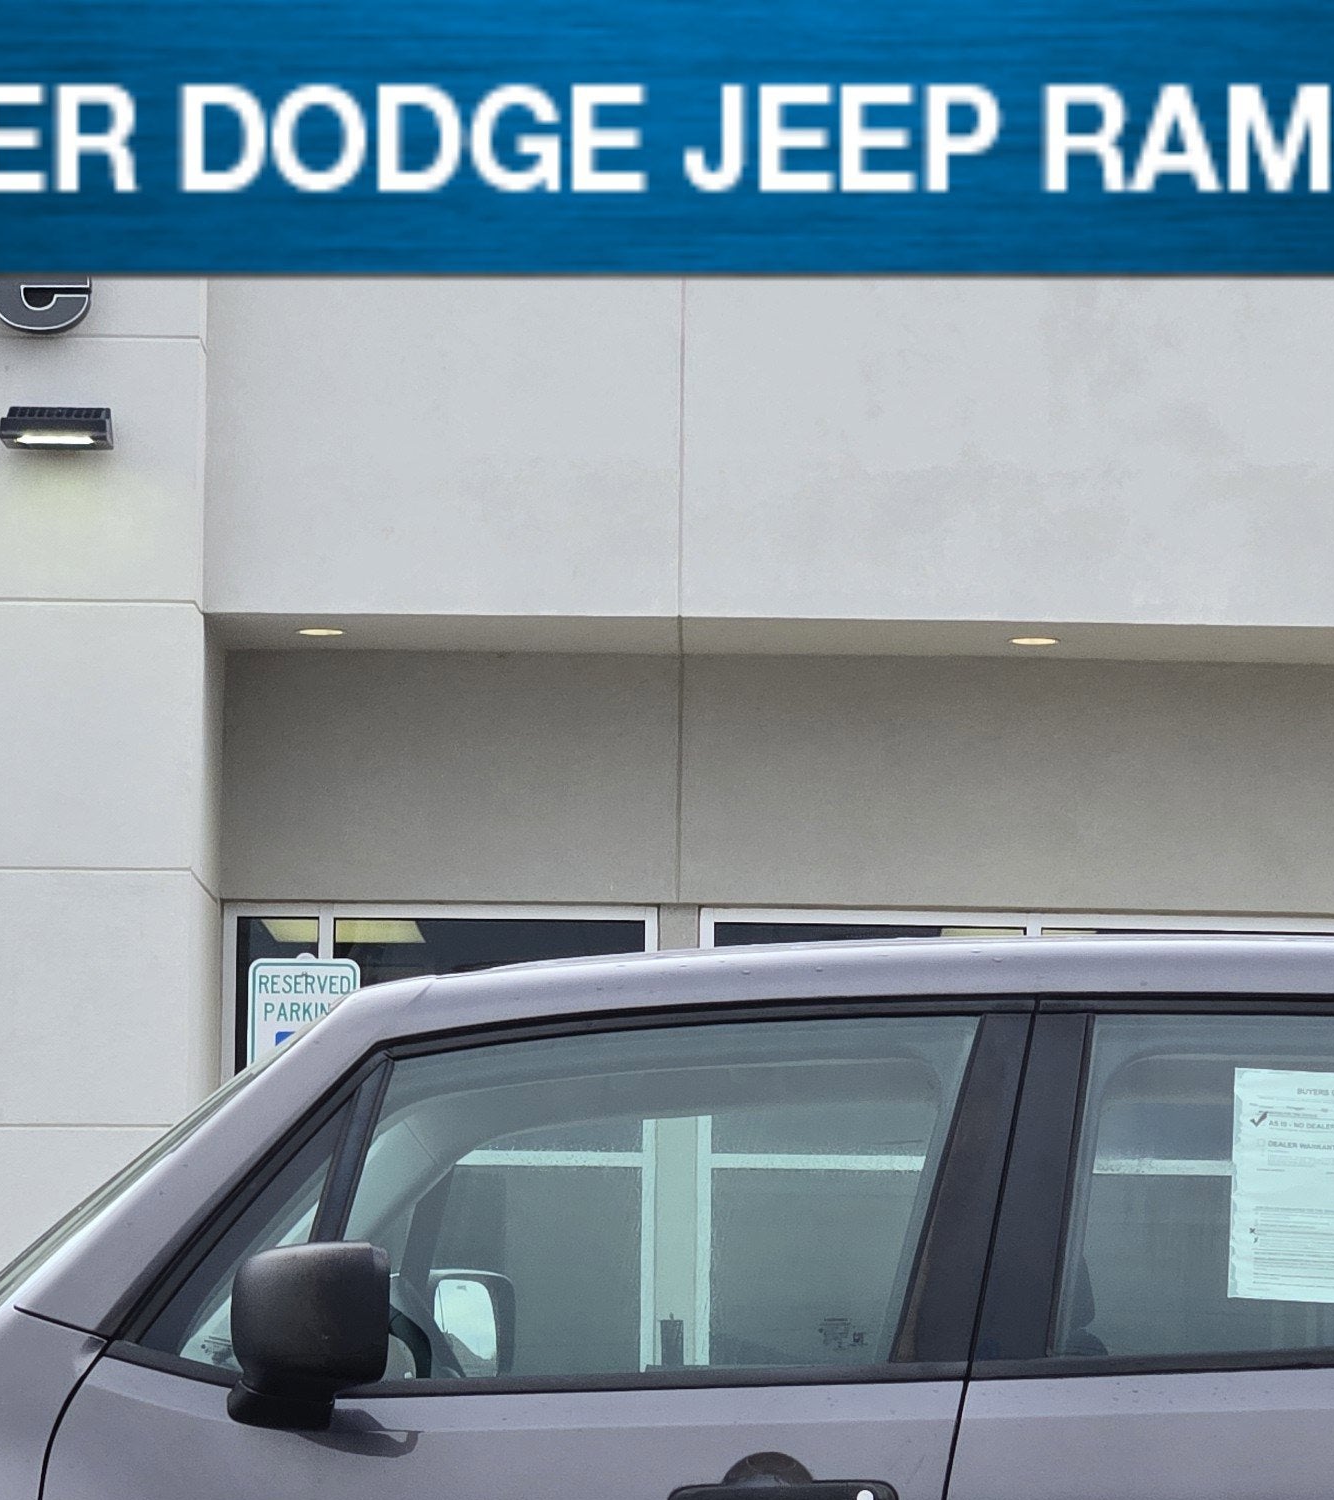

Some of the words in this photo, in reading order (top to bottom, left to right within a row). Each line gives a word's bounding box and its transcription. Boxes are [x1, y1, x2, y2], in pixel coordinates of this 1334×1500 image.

[258, 974, 351, 995] RESERVED
[264, 1002, 330, 1022] PARKIN
[1267, 1140, 1298, 1149] DEALER
